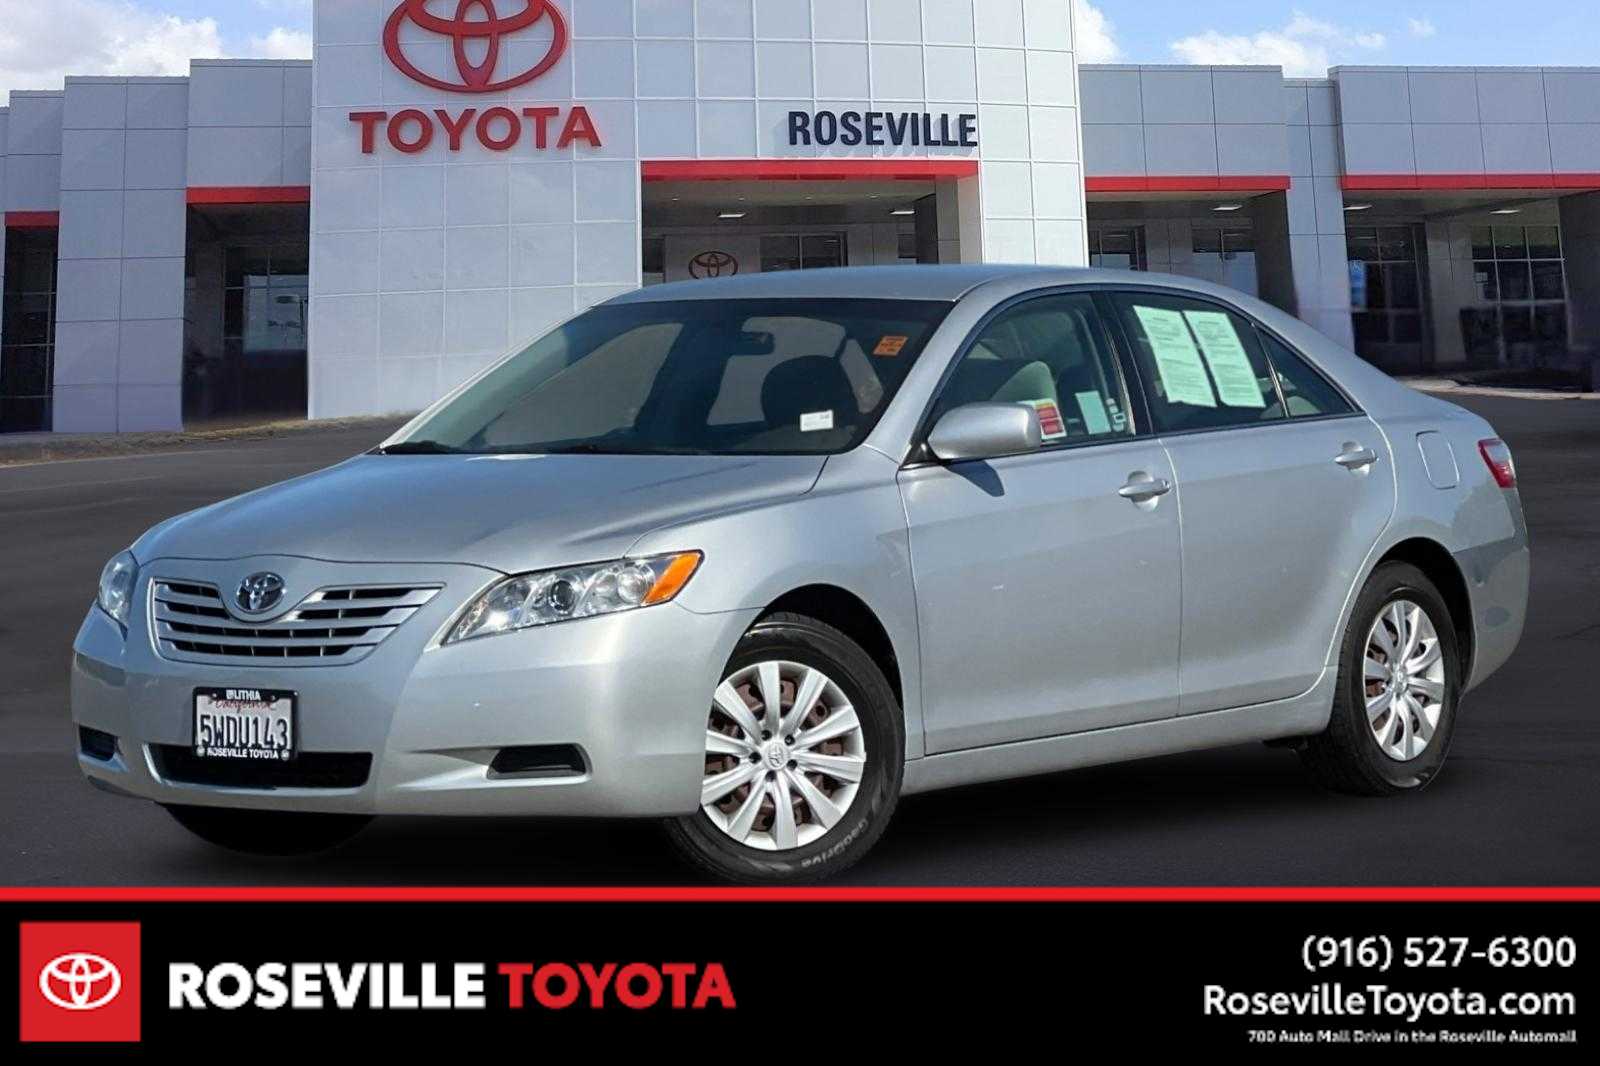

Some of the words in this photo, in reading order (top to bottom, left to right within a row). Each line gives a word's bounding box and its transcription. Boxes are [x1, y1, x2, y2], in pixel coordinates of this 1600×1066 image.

[349, 106, 602, 154] TOYOTA
[788, 111, 978, 148] ROSEVILLE
[200, 714, 288, 750] 5WDU143
[207, 747, 248, 758] ROSEVILLE
[249, 749, 279, 759] TOYOTA
